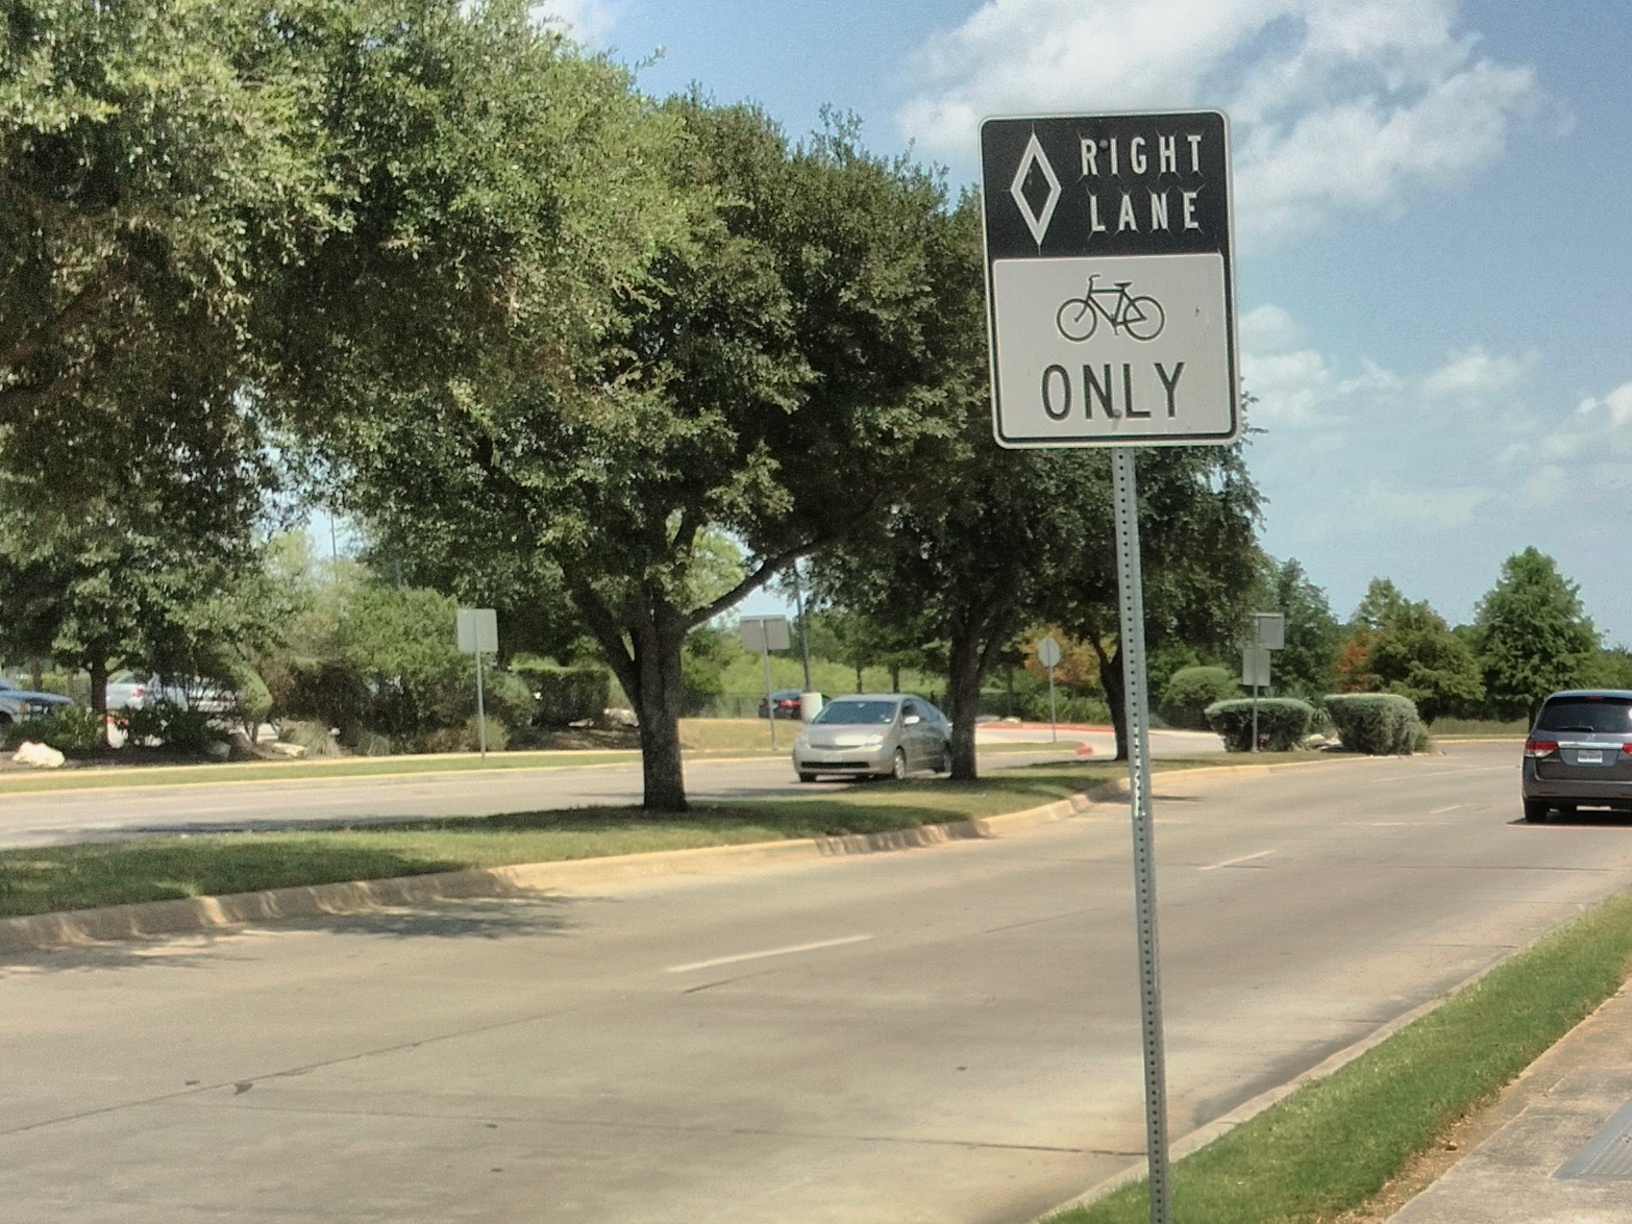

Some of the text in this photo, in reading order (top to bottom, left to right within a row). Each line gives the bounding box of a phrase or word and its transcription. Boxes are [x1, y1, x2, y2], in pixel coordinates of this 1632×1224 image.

[1081, 135, 1201, 176] RIGHT
[1090, 191, 1200, 232] LANE
[1041, 362, 1185, 421] ONLY
